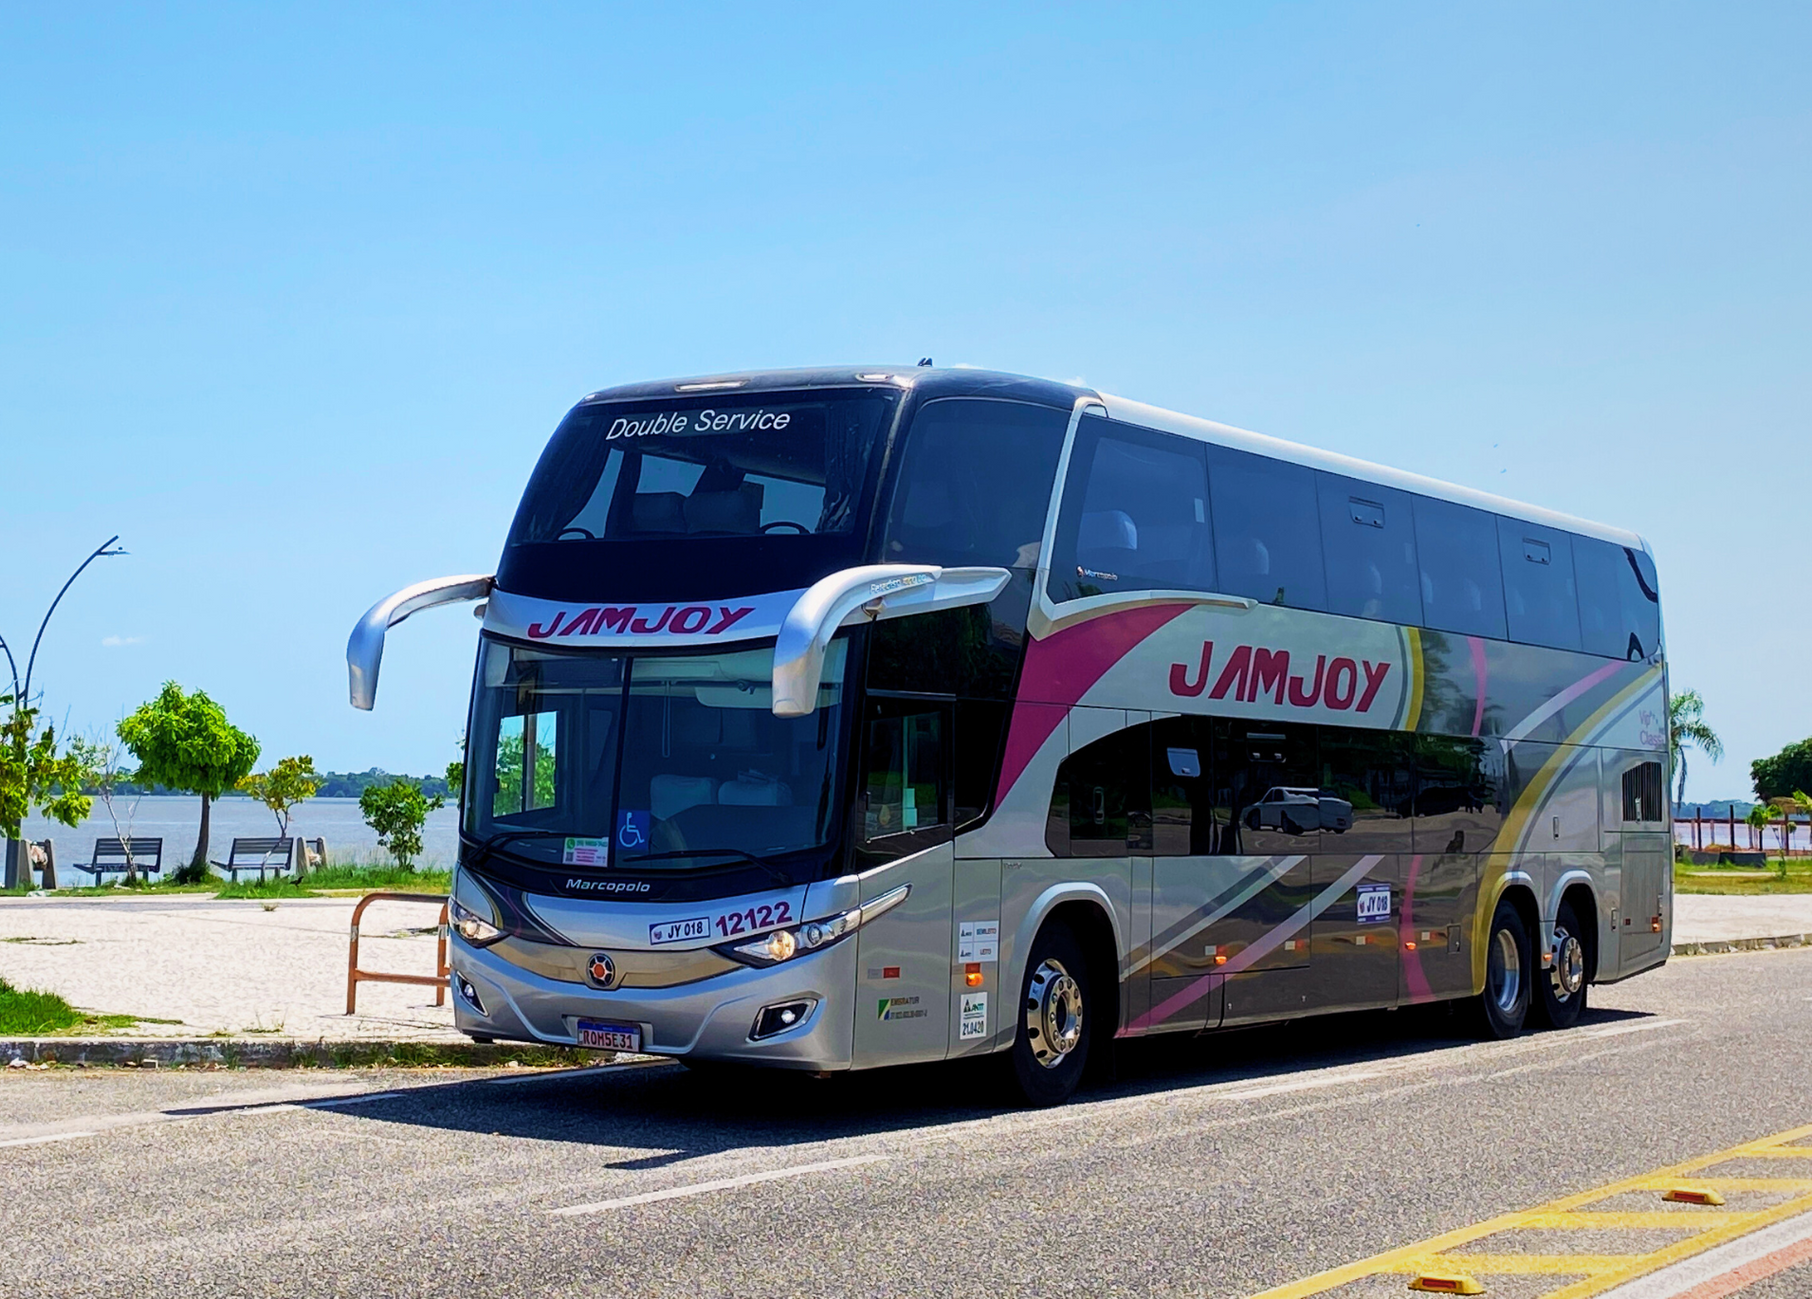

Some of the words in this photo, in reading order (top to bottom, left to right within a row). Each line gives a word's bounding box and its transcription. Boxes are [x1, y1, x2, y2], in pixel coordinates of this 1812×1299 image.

[605, 411, 688, 441] Double
[694, 409, 791, 432] Service
[527, 606, 756, 639] JAMJOY
[1169, 640, 1391, 713] JAMJOY
[565, 878, 651, 893] Marcopolo
[1367, 896, 1377, 912] JY
[667, 924, 682, 939] JY
[684, 921, 703, 936] 018
[715, 901, 793, 937] 12122
[583, 1030, 634, 1050] ROM5E31
